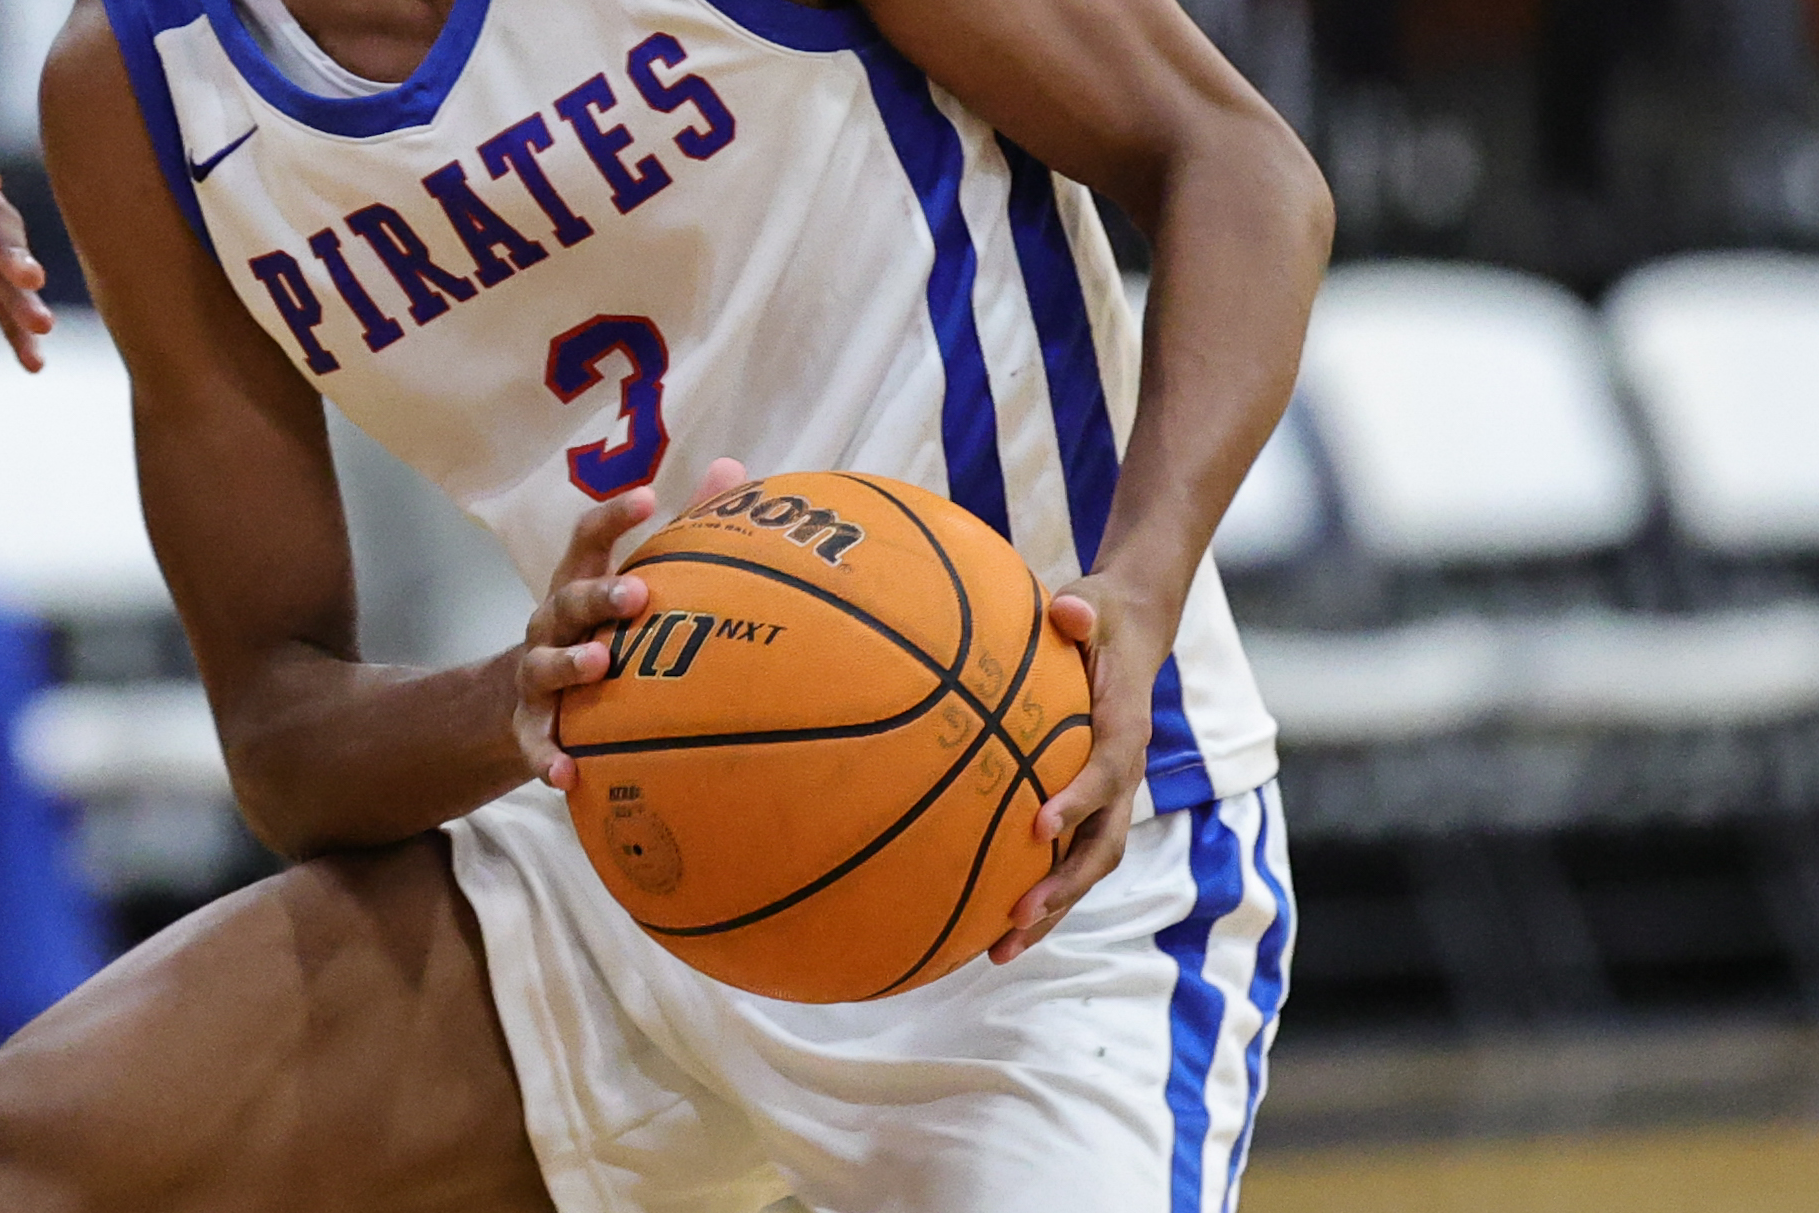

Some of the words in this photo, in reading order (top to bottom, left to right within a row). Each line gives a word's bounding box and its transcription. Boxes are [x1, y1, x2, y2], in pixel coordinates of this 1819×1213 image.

[247, 31, 737, 376] PIRATES
[544, 313, 671, 503] 3
[715, 617, 788, 646] NXT
